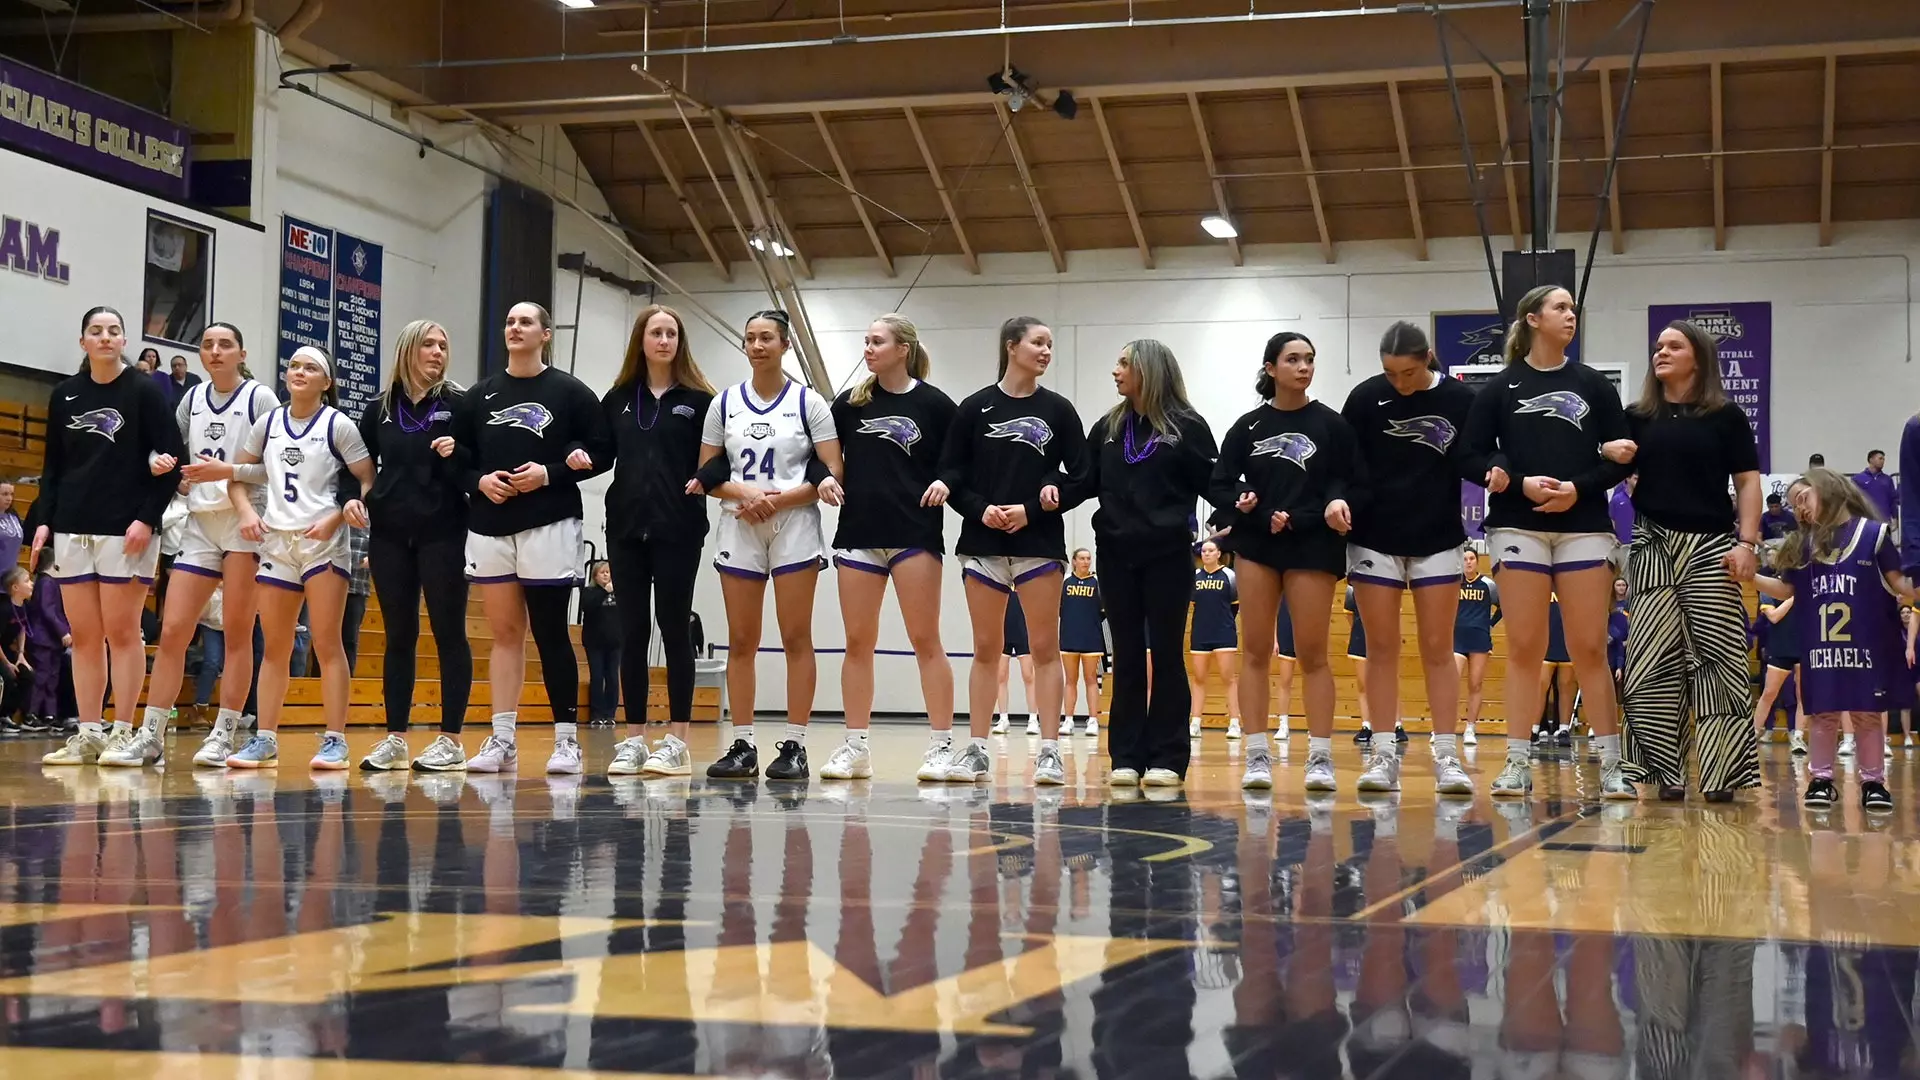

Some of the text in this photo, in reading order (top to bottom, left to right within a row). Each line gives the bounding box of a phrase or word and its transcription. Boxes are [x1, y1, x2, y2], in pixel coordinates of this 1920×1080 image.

[0, 82, 184, 178] CHAEL'S COLLEGE
[299, 279, 315, 290] 1994
[338, 301, 379, 319] FIELD HOCKEY
[1717, 351, 1754, 359] ETBALL
[1734, 395, 1758, 404] 1959
[1743, 408, 1758, 417] 67
[741, 448, 775, 480] 24
[284, 472, 299, 503] 5
[1066, 585, 1095, 597] SNHU
[1195, 580, 1225, 590] SNHU
[1812, 574, 1857, 599] SAINT
[1460, 589, 1485, 600] NHU
[1818, 602, 1852, 642] 12
